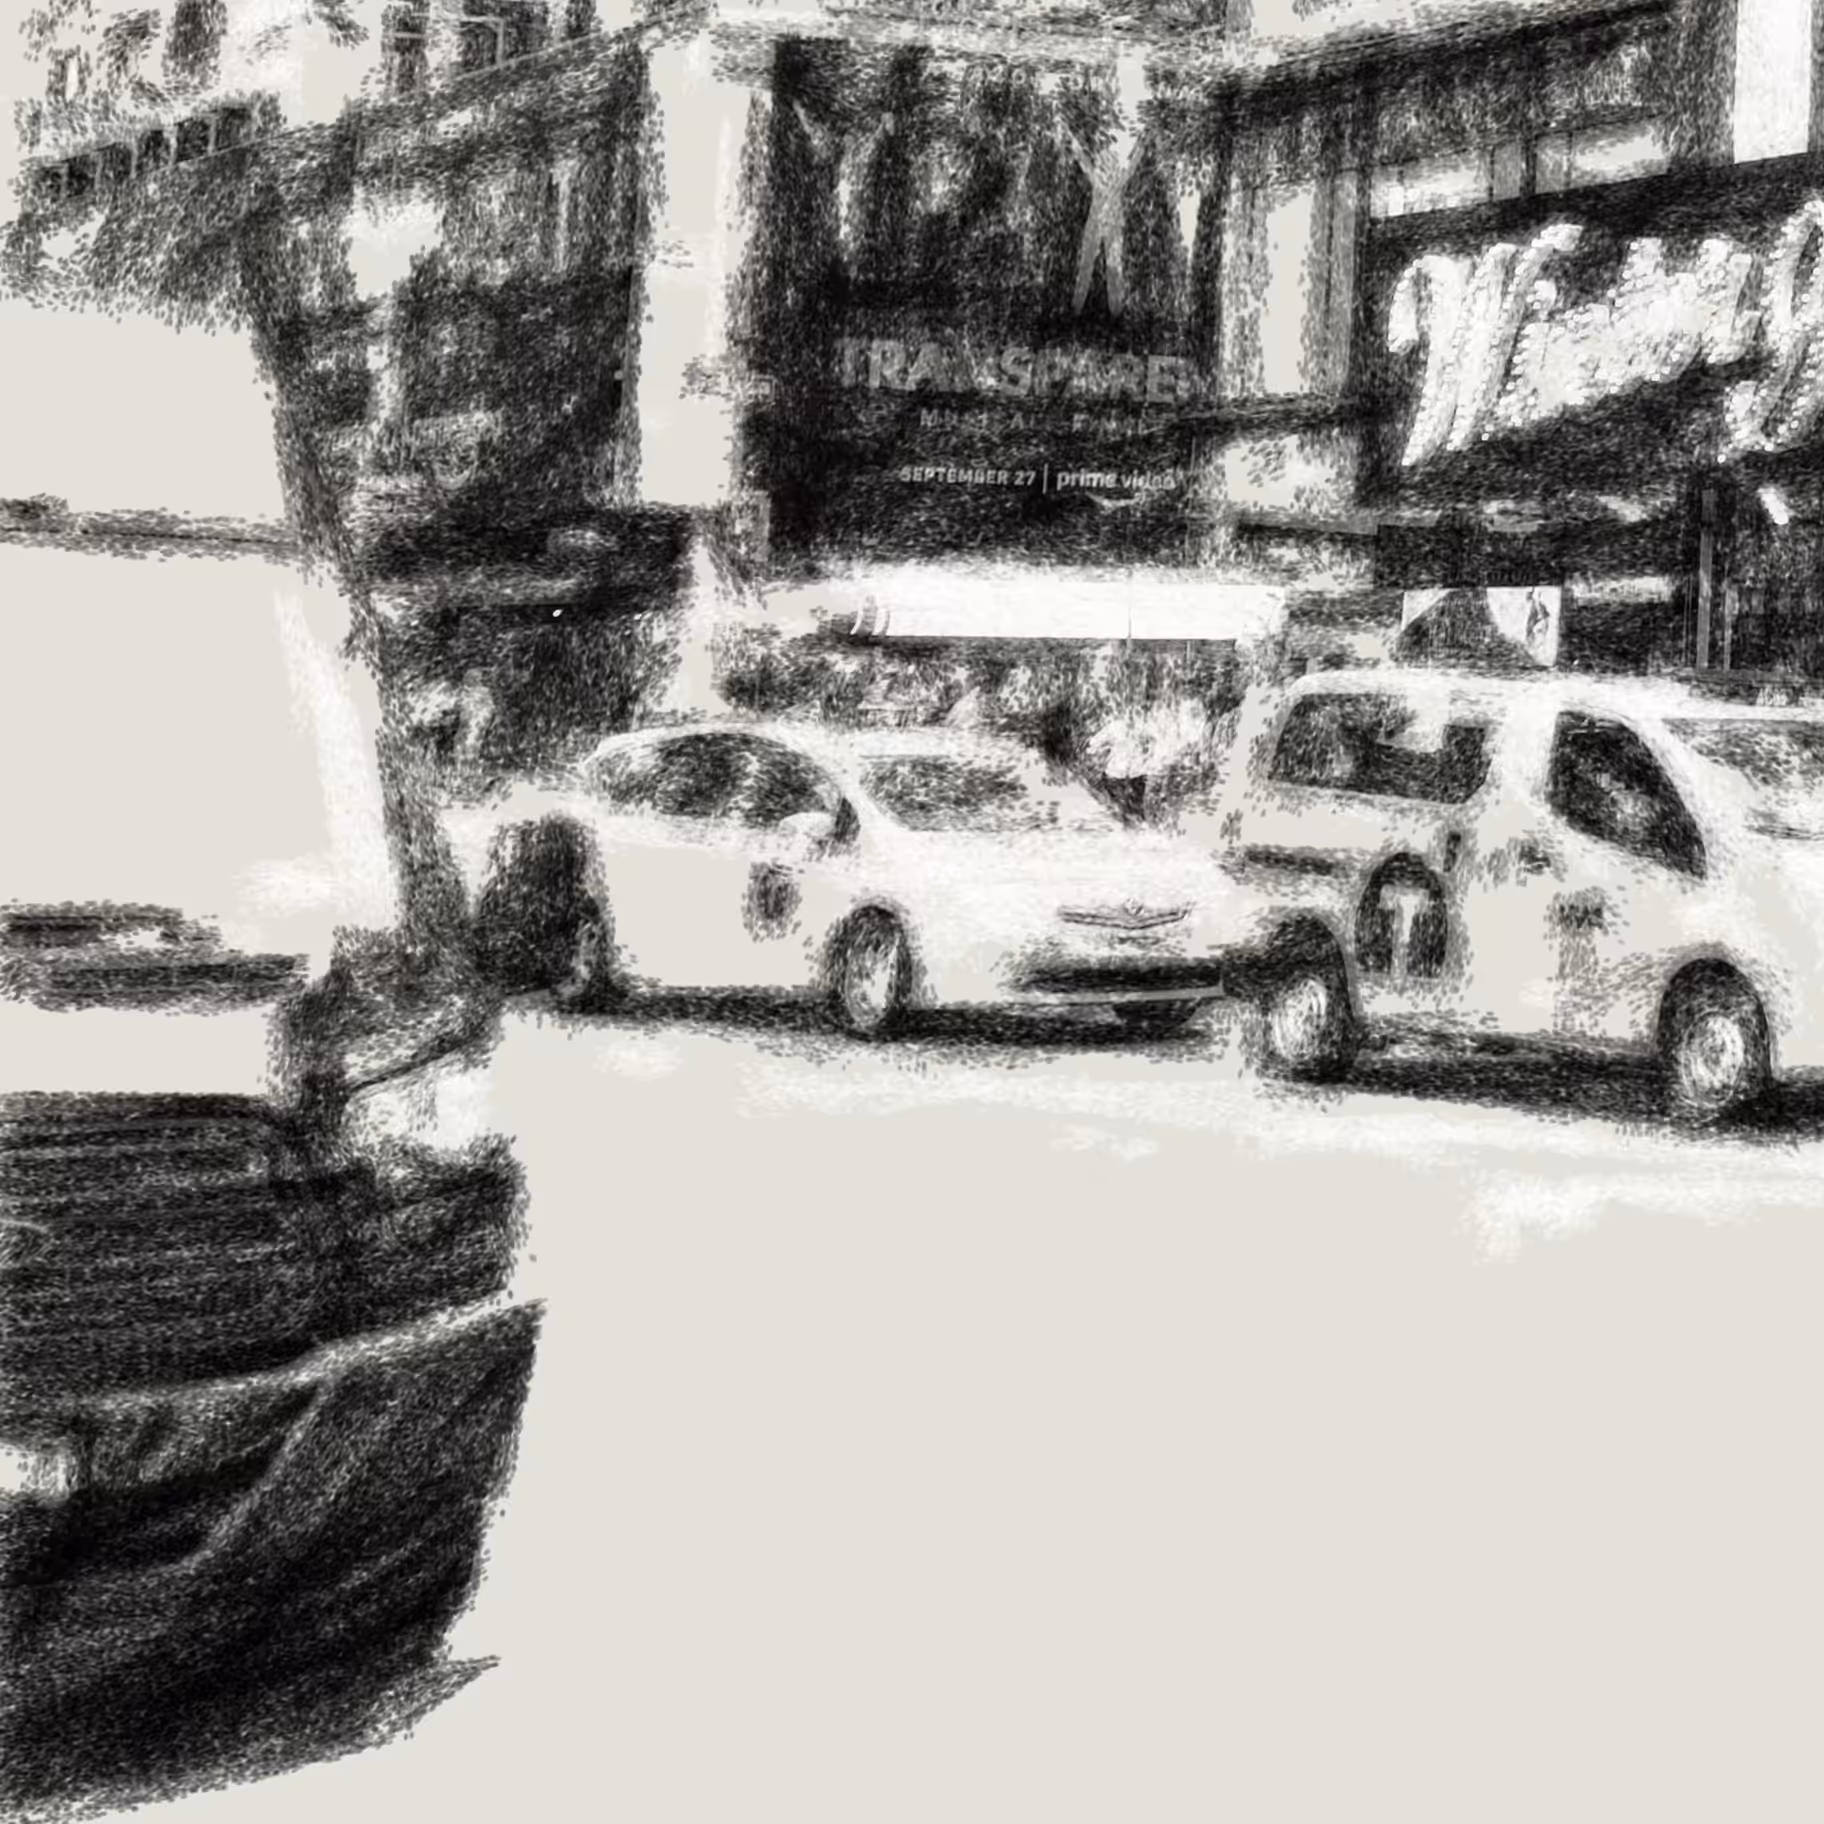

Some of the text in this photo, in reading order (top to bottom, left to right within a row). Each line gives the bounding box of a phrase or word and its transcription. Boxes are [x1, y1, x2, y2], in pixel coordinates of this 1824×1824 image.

[900, 465, 1008, 485] SEPTEMBER
[1013, 470, 1036, 486] 27
[1057, 468, 1117, 491] prime
